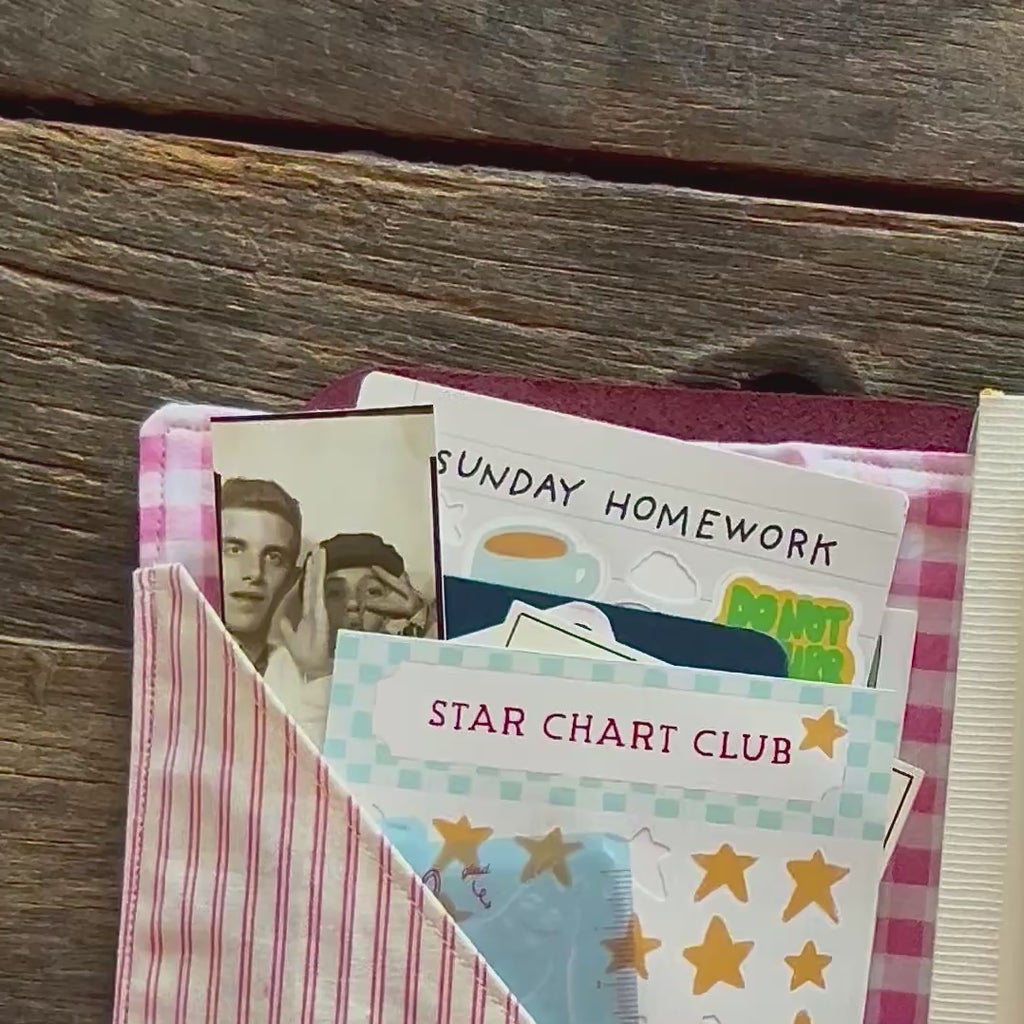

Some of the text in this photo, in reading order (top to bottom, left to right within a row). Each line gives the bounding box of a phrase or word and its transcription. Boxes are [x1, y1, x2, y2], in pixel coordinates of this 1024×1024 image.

[435, 449, 838, 567] SUNDAY HOMEWORK
[776, 597, 850, 647] NOT
[428, 699, 792, 765] STAR CHART CLUB
